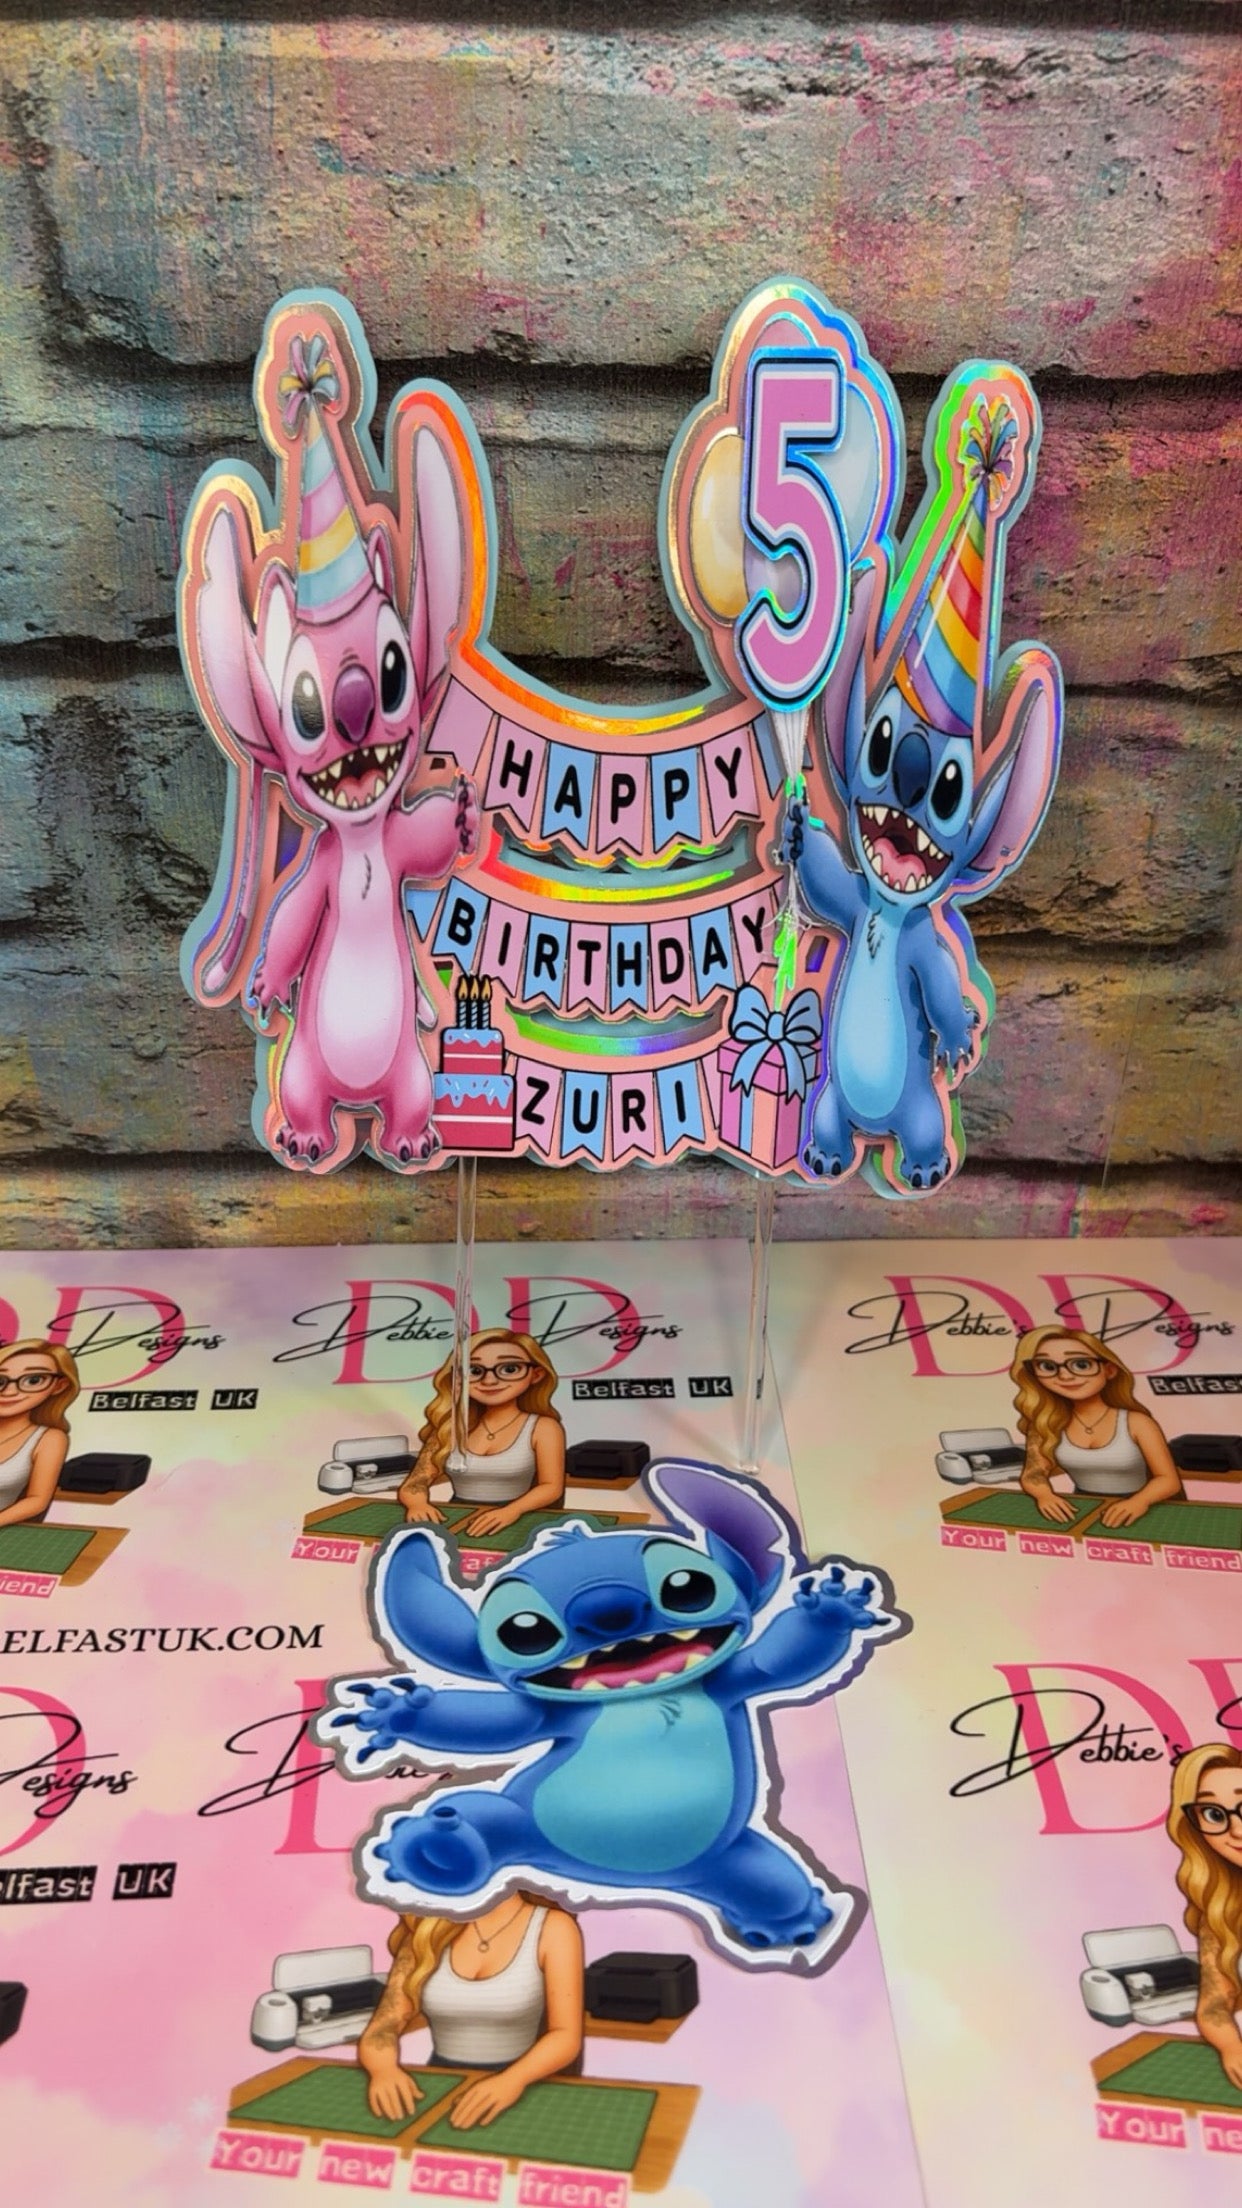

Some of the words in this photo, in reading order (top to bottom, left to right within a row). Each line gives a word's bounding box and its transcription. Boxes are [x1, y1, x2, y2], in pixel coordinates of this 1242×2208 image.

[740, 352, 845, 699] 5
[500, 739, 741, 824] HAPPY
[447, 897, 766, 988] BIRTHDAY
[521, 1077, 685, 1134] ZURI
[47, 1301, 226, 1364] Designs
[505, 1291, 685, 1353] Designs
[1055, 1289, 1236, 1349] Designs
[92, 1392, 196, 1410] Belfast
[214, 1390, 257, 1407] UK
[574, 1380, 674, 1398] Belfast
[692, 1378, 731, 1394] UK
[1150, 1378, 1242, 1393] Belfas
[297, 1541, 358, 1560] Your
[942, 1528, 1005, 1549] Your
[1020, 1537, 1072, 1555] new
[1086, 1543, 1151, 1563] craft
[1166, 1549, 1241, 1570] friend
[1, 1624, 325, 1654] ELFASTUK.COM
[0, 1873, 93, 1899] lfast
[119, 1867, 171, 1893] UK
[1099, 2110, 1184, 2143] Your
[218, 2138, 299, 2171] Your
[321, 2154, 391, 2184] new
[413, 2164, 500, 2197] craft
[519, 2170, 627, 2208] friend
